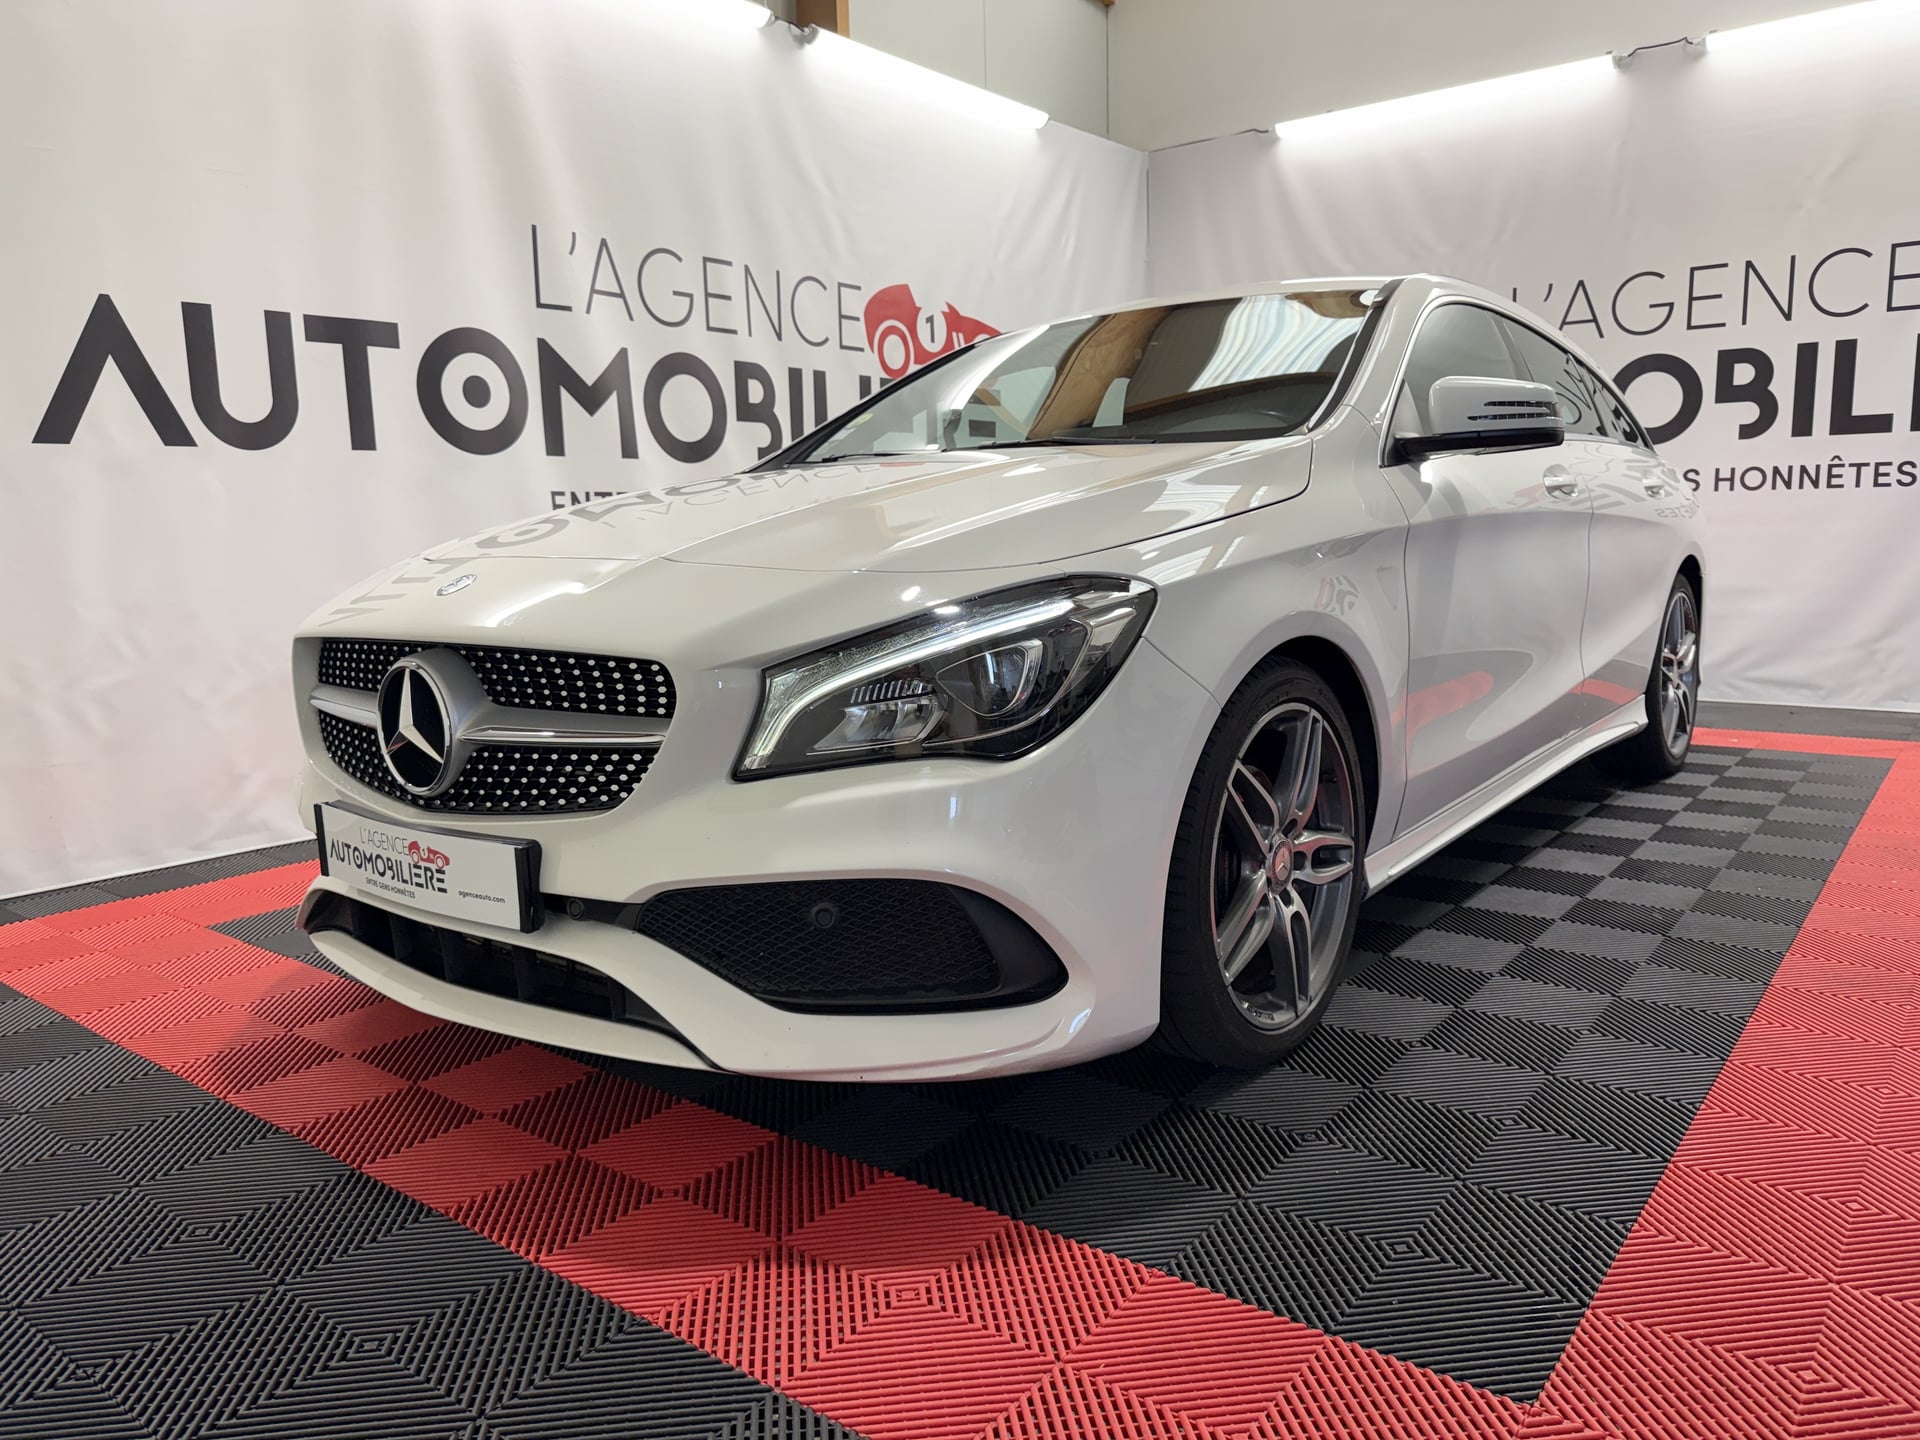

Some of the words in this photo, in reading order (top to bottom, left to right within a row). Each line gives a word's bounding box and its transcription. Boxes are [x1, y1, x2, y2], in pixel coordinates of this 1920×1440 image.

[530, 224, 866, 353] L'AGENCE
[925, 314, 936, 344] 1
[1713, 455, 1918, 492] HONNÊTES
[360, 827, 409, 856] L'AGENCE
